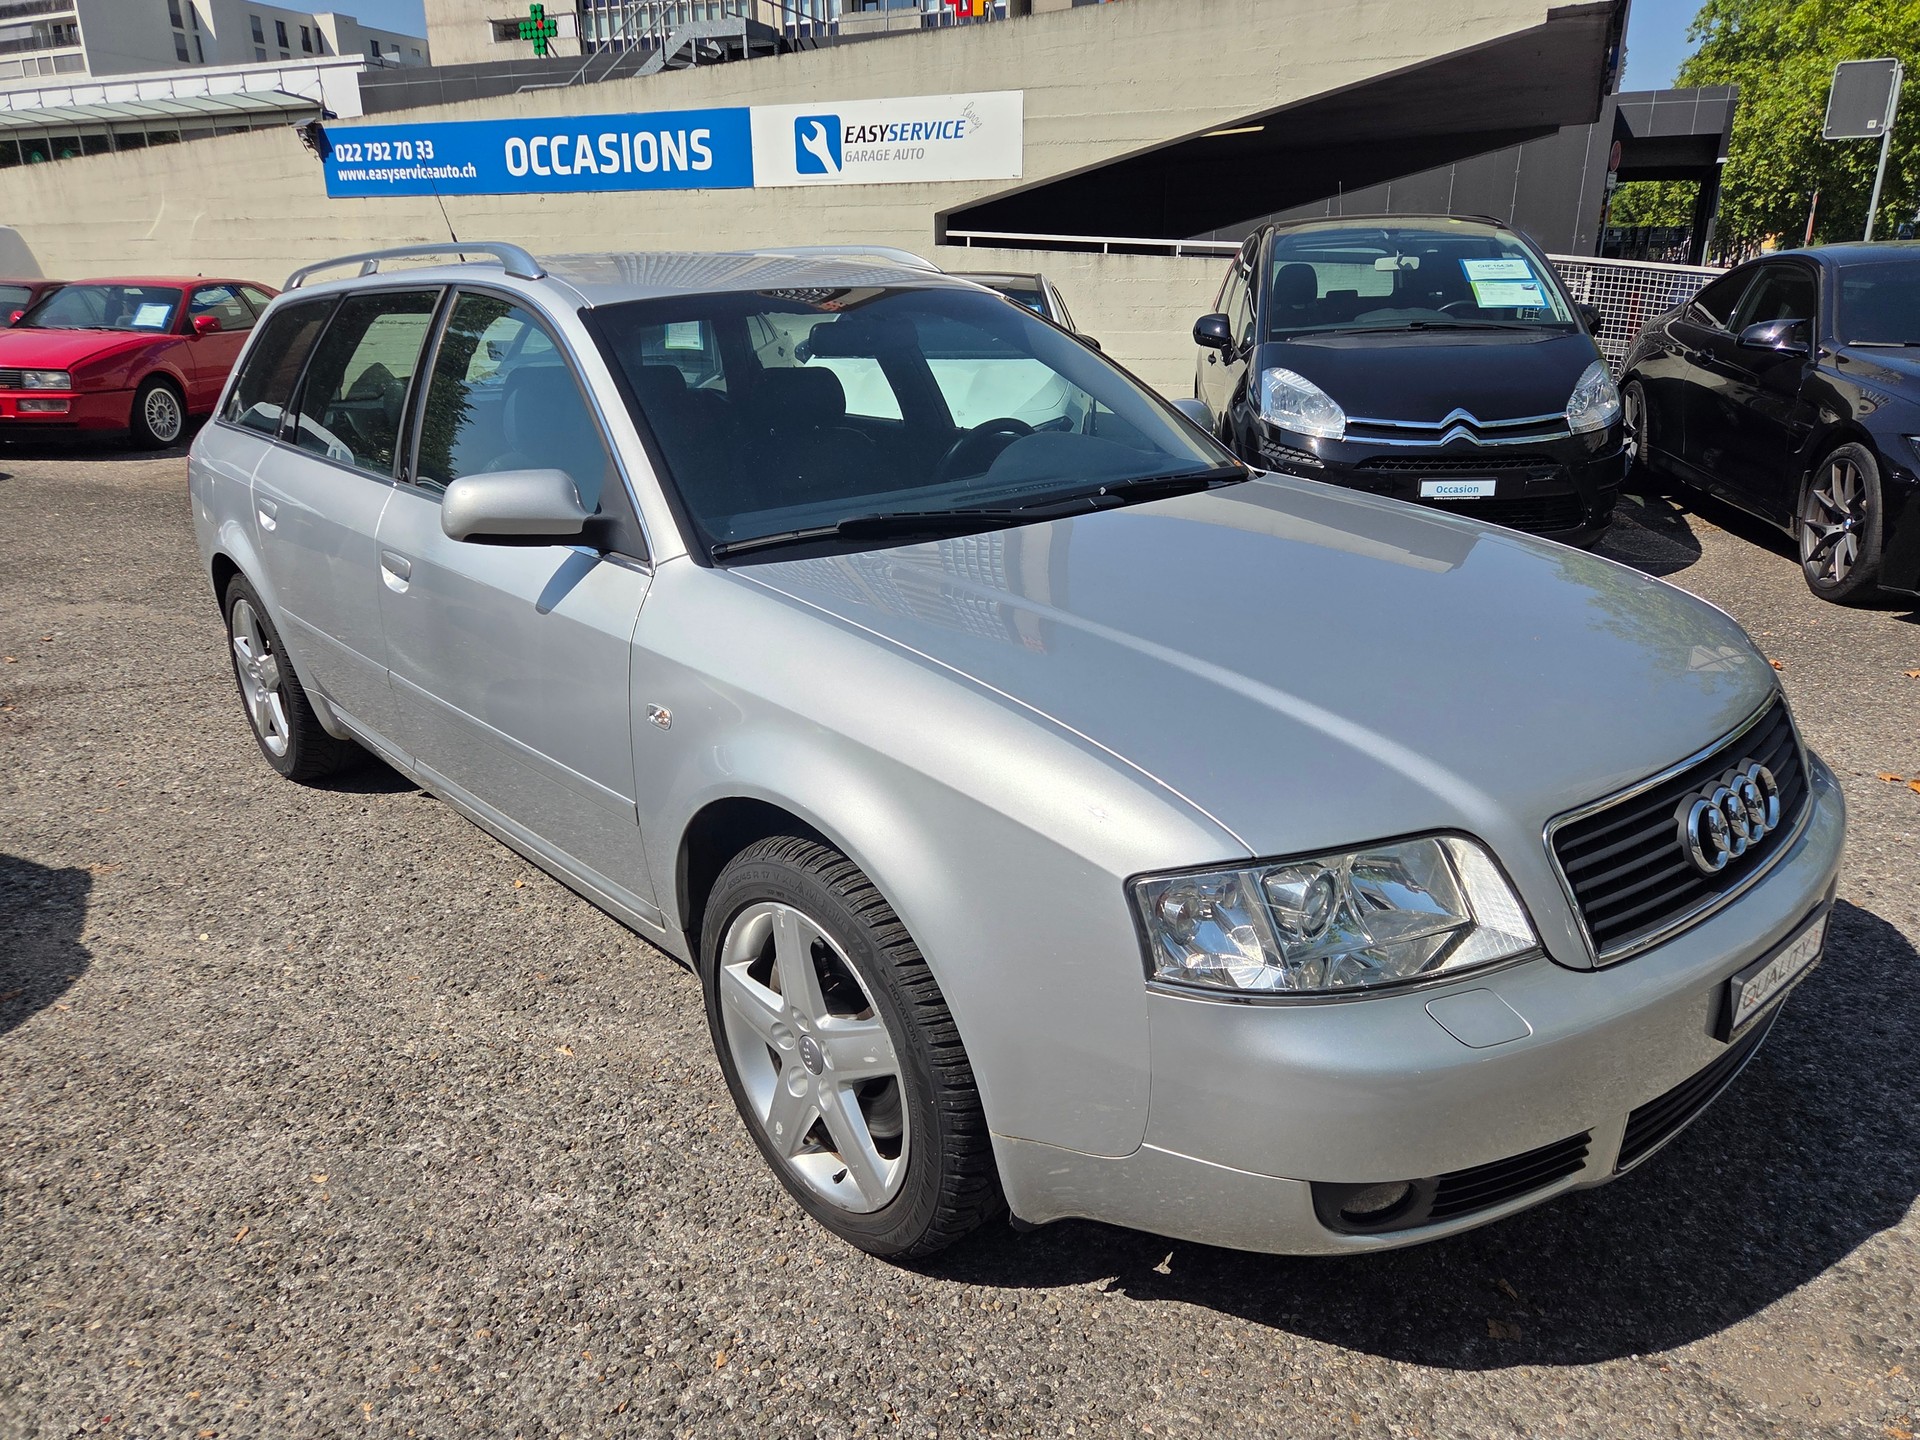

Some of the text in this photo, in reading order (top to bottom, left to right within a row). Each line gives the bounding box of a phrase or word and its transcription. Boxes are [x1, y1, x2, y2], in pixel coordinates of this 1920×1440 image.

[844, 119, 966, 144] EASYSERVICE
[335, 140, 434, 162] 022 792 70 33
[504, 128, 713, 177] OCCASIONS
[844, 147, 925, 163] GARAGE AUTO
[338, 162, 477, 183] www.easyserviceauto.ch
[1436, 485, 1479, 494] Occasion
[889, 983, 919, 1043] ROTATION
